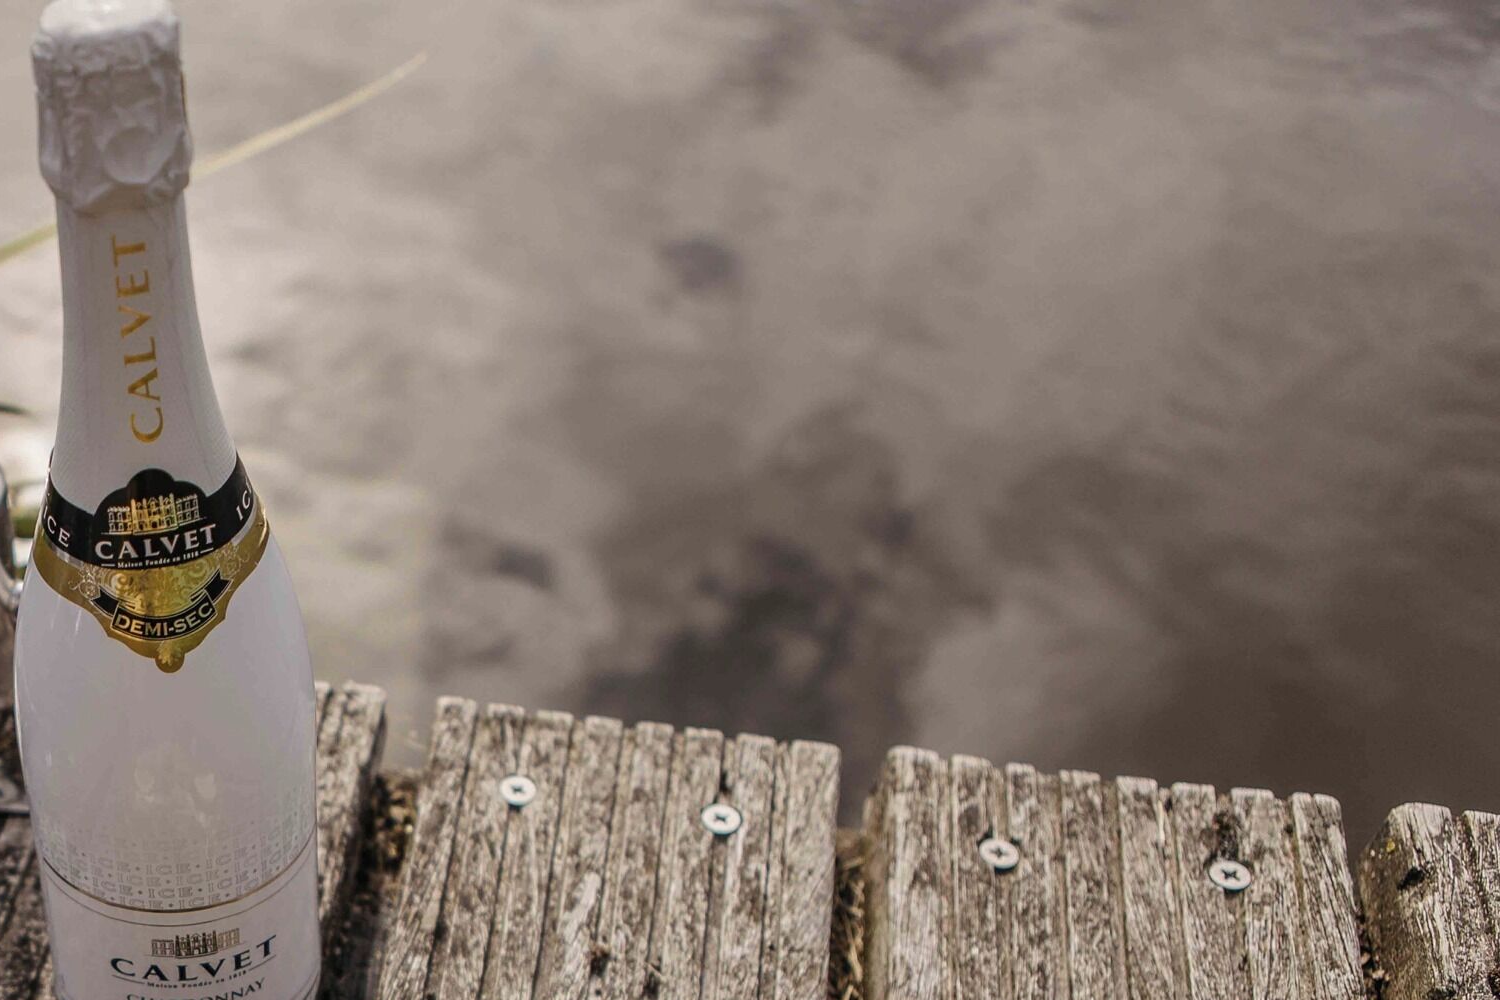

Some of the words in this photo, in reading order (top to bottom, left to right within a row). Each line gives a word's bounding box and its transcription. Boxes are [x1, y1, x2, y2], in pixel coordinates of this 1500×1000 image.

[111, 234, 164, 444] CALVET
[43, 505, 70, 548] ICE
[94, 523, 217, 561] CALVET
[117, 561, 143, 569] Maison
[115, 601, 214, 636] DEMI-SEC
[110, 934, 277, 982] CALVET
